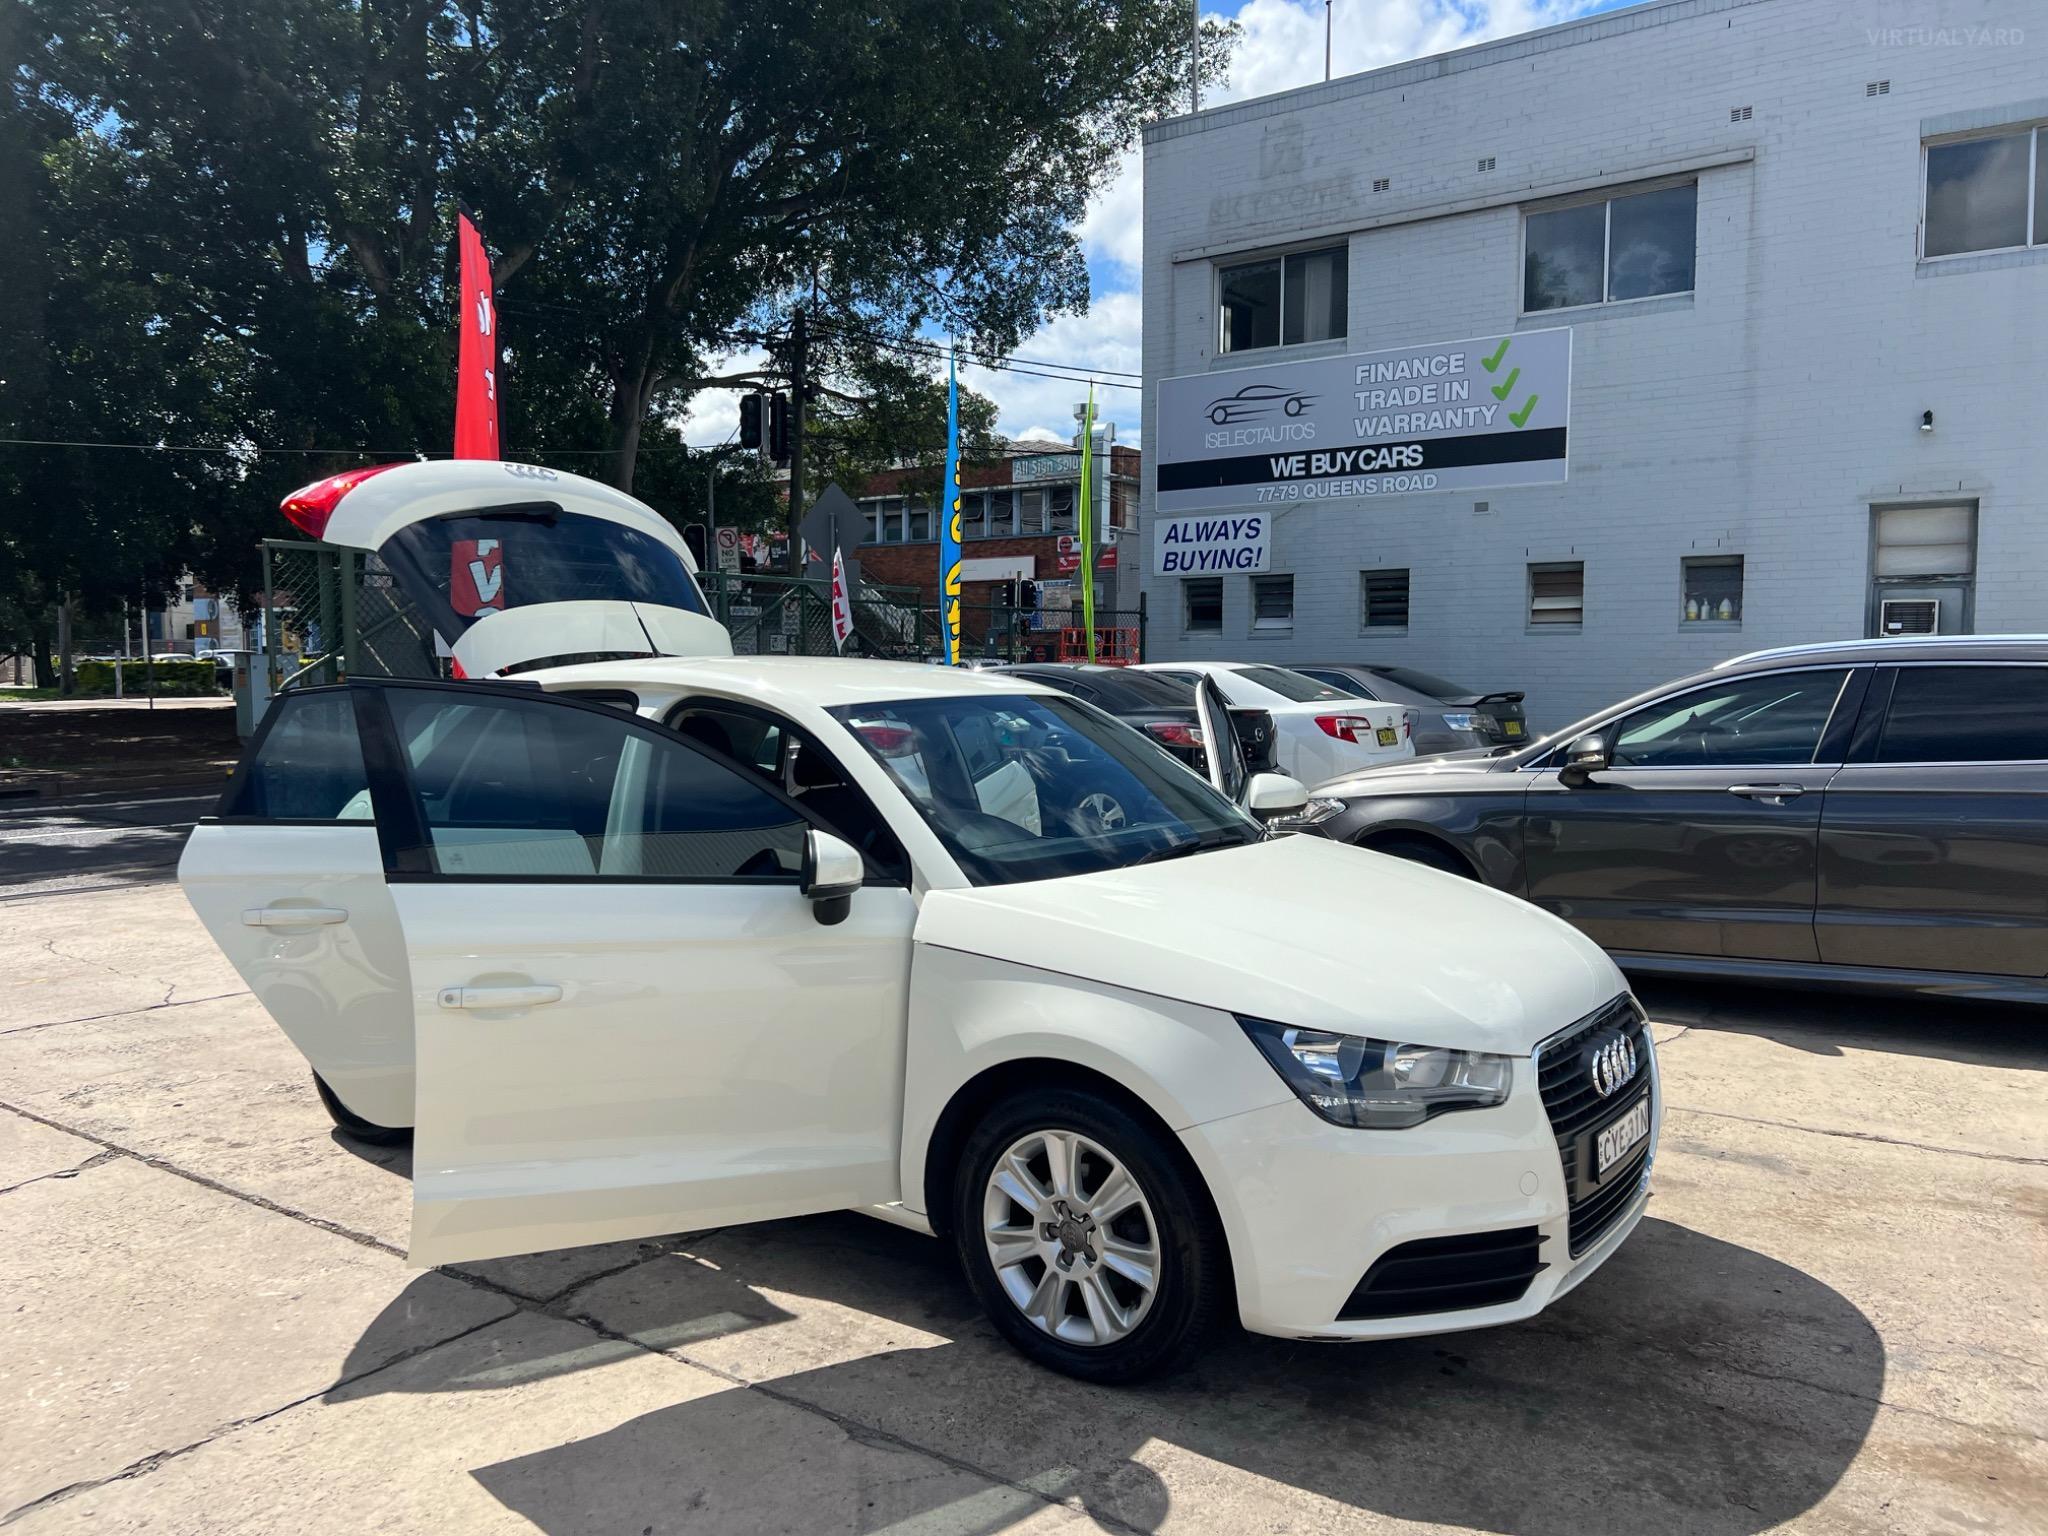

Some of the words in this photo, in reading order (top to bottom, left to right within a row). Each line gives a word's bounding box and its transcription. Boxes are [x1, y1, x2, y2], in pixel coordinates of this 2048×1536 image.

[1355, 352, 1465, 385] FINANCE
[1354, 383, 1438, 411] TRADE
[1443, 379, 1470, 402] IN
[1354, 403, 1499, 438] WARRANTY
[1205, 422, 1316, 449] ISELECTAUTOS
[1015, 461, 1029, 476] All
[1031, 459, 1054, 474] Sign
[1270, 455, 1307, 478] WE
[1311, 450, 1358, 475] BUY
[1358, 444, 1424, 470] CARS
[1256, 485, 1300, 502] 77-79
[1303, 479, 1378, 498] QUEENS
[1382, 474, 1438, 493] ROAD
[1163, 517, 1262, 545] ALWAYS
[721, 549, 735, 557] NO
[1162, 547, 1263, 572] BUYING!
